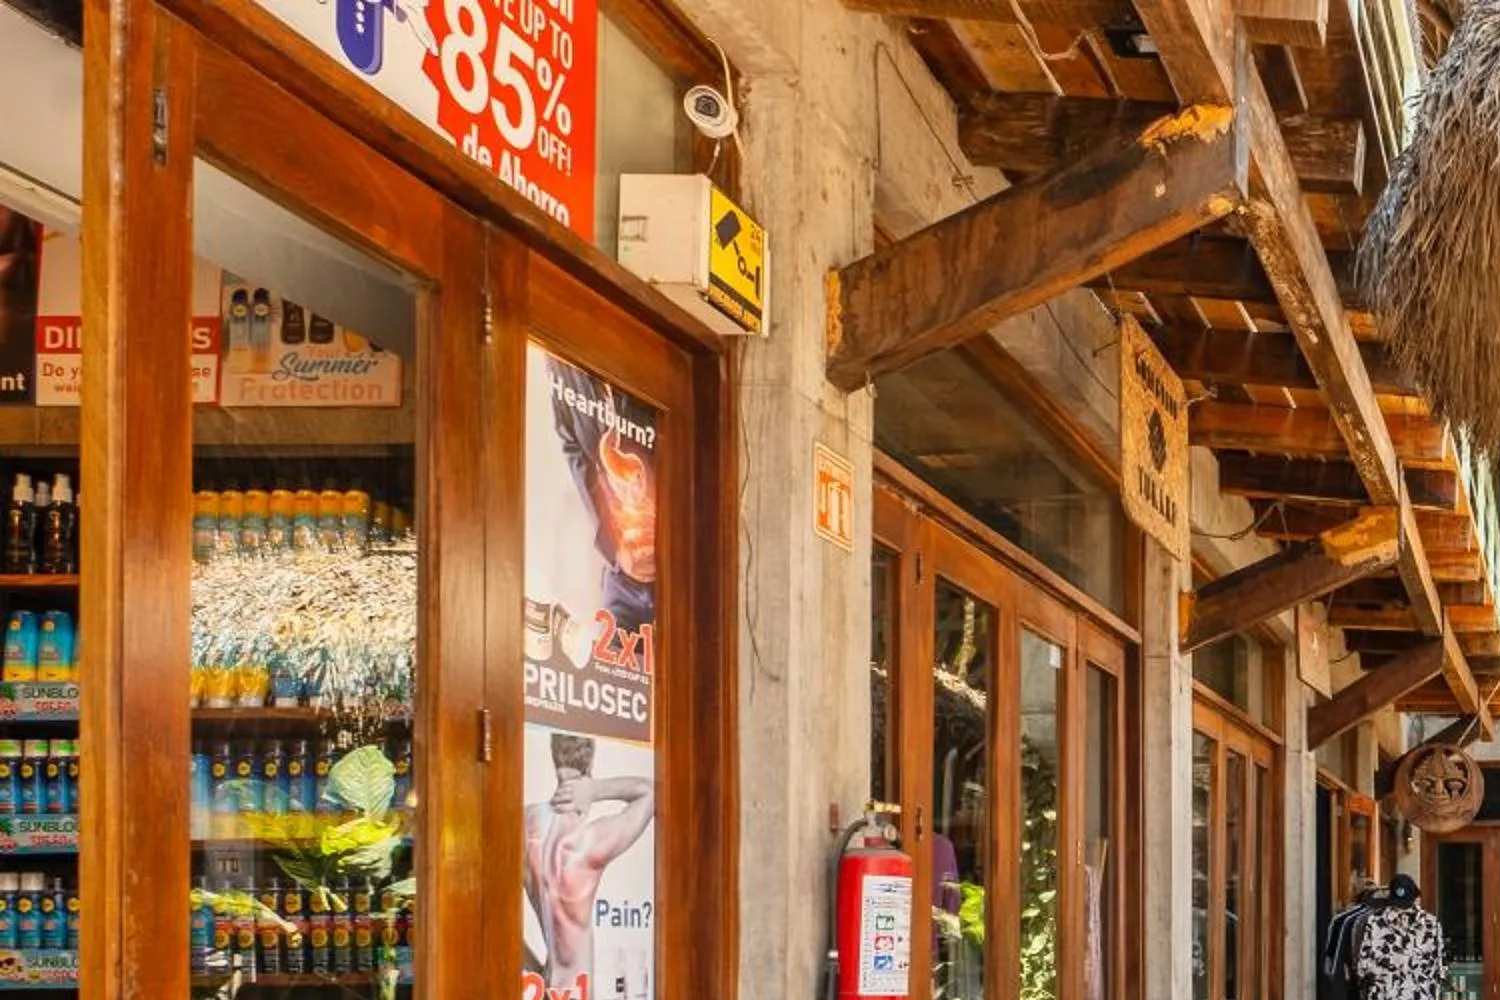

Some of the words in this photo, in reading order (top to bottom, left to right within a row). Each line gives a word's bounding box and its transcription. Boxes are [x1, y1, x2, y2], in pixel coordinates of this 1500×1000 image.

[519, 0, 546, 42] UP
[549, 19, 574, 70] TO
[537, 125, 572, 177] OFF!
[462, 123, 492, 169] de
[499, 150, 571, 228] Ahorro
[44, 326, 82, 349] DI
[272, 352, 380, 381] Summer
[0, 373, 26, 391] nt
[238, 377, 383, 400] Protection
[548, 371, 656, 449] Heartburn?
[592, 607, 654, 676] 2x1
[22, 686, 80, 699] SUNBLO
[523, 661, 648, 723] PRILOSEC
[19, 820, 75, 833] SUNBLO
[595, 899, 653, 929] Pain?
